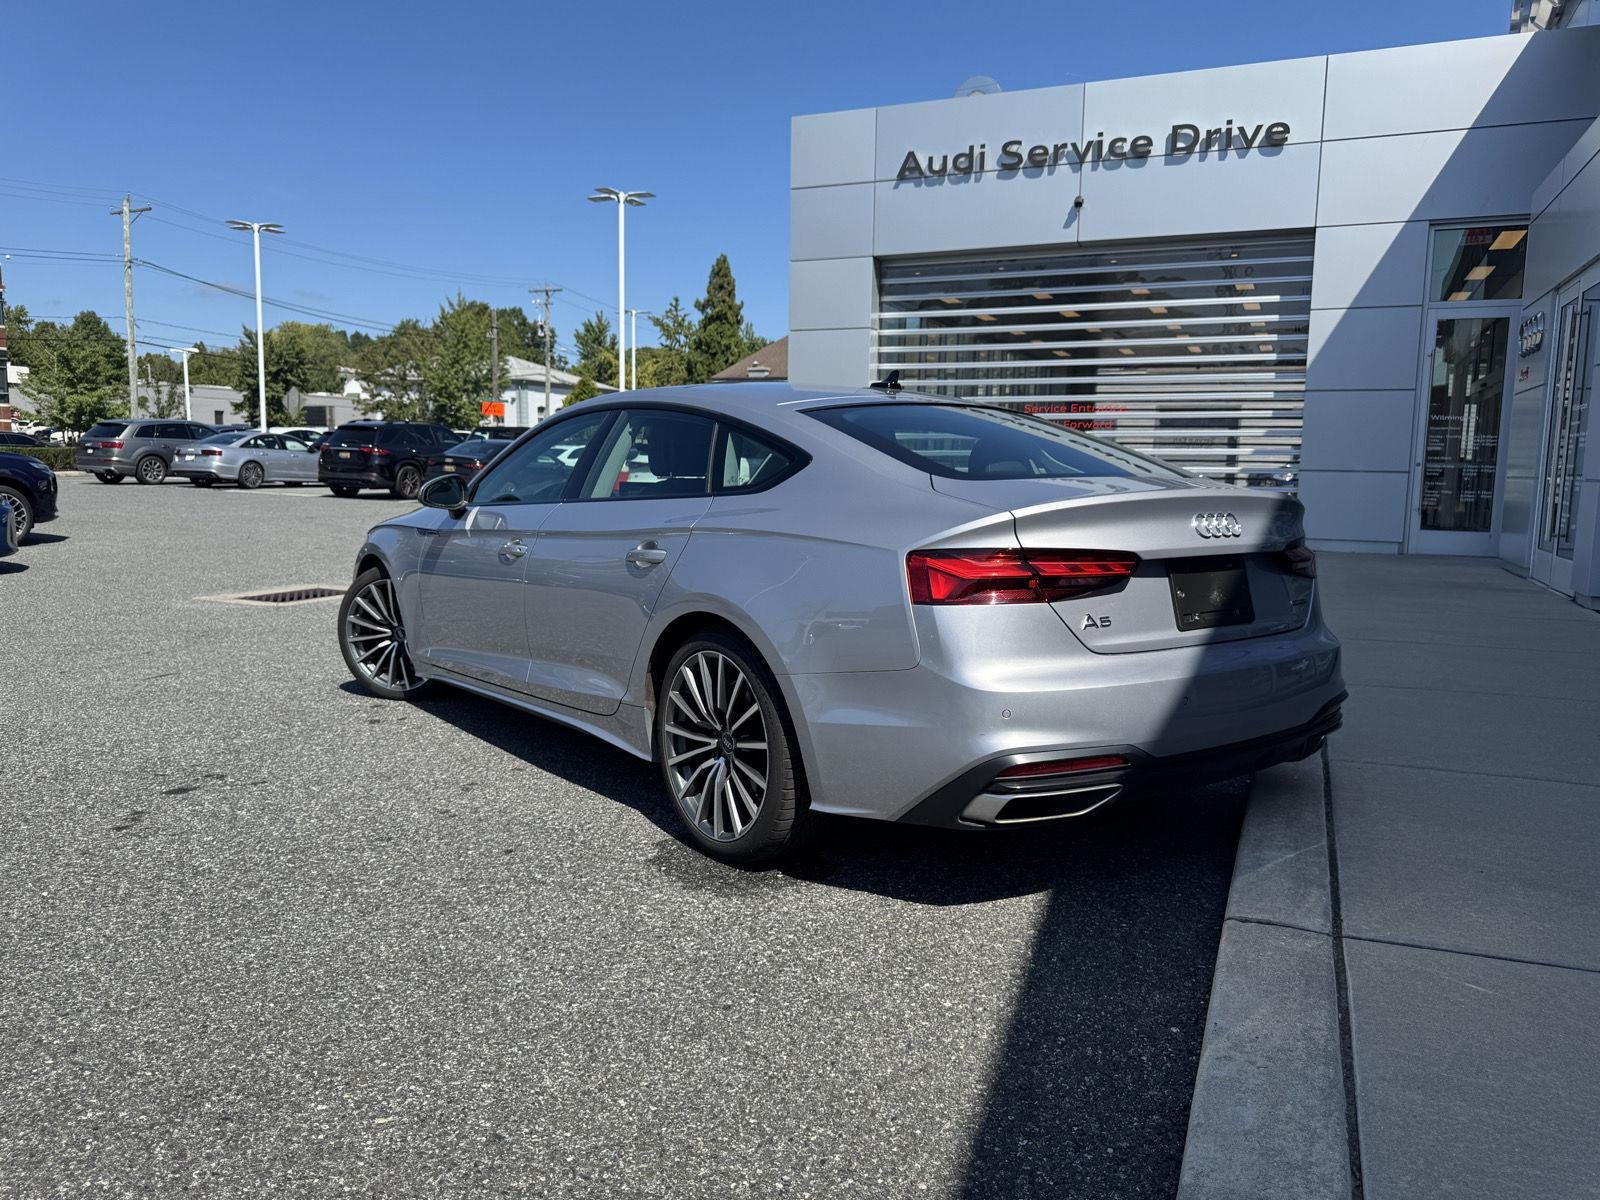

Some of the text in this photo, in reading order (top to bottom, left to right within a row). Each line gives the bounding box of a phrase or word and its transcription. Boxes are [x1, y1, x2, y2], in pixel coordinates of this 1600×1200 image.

[898, 119, 1291, 180] Audi Service Drive
[1024, 403, 1067, 414] Service
[1431, 414, 1479, 422] Wilmingn
[1063, 420, 1113, 430] Forward
[1081, 613, 1112, 630] A5
